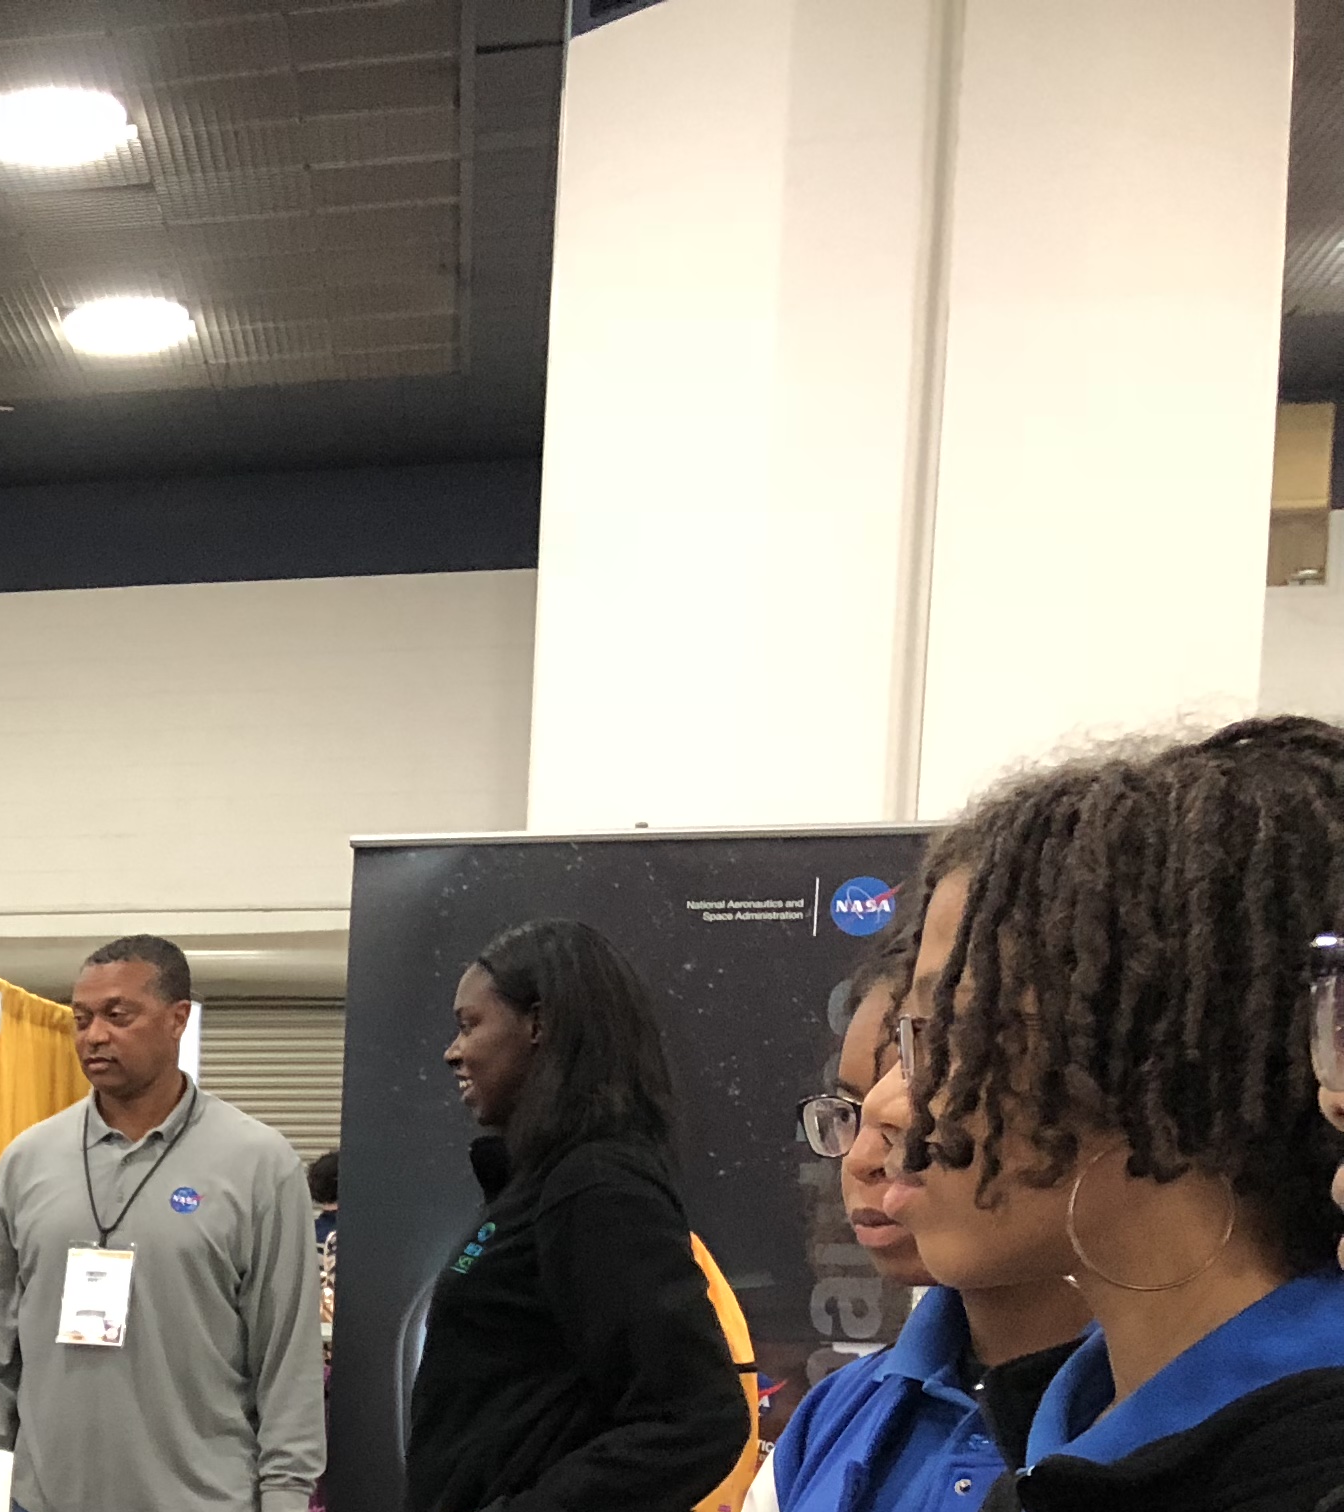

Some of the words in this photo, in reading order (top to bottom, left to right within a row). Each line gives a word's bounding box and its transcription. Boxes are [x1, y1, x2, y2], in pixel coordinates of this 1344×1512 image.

[686, 900, 725, 910] National
[728, 898, 783, 908] Aeronautics
[785, 898, 804, 908] and
[835, 899, 891, 913] NASA
[703, 912, 733, 922] Space
[735, 910, 803, 921] Administration
